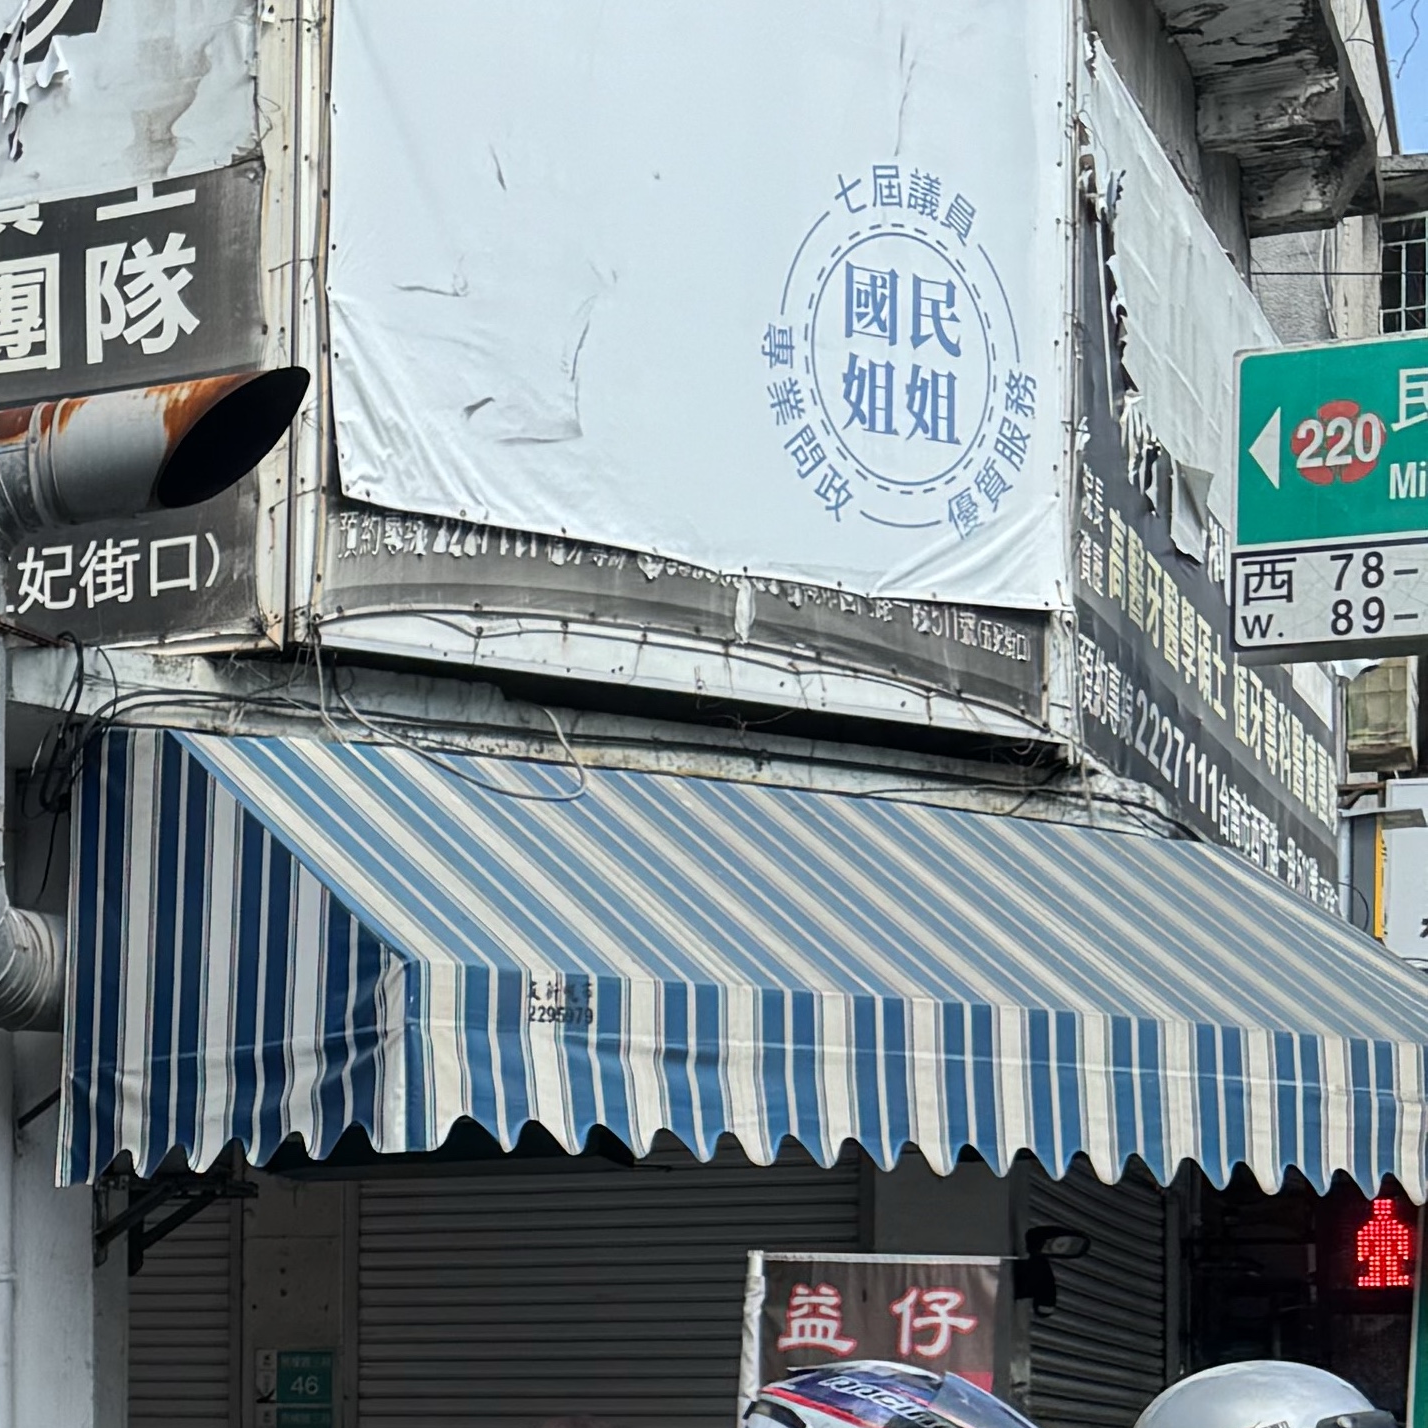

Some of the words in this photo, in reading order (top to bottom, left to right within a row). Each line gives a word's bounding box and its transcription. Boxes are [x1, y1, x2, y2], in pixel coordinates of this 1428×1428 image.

[842, 261, 963, 358] 國民
[761, 321, 854, 522] 專業問政
[840, 351, 961, 446] 姐姐
[1295, 411, 1383, 469] 220
[947, 369, 1038, 540] 優質服務
[7, 531, 222, 615] 妃街口)
[1241, 556, 1297, 606] 西
[1134, 690, 1219, 824] 2227111
[777, 1282, 979, 1358] 益仔
[289, 1375, 320, 1396] 46
